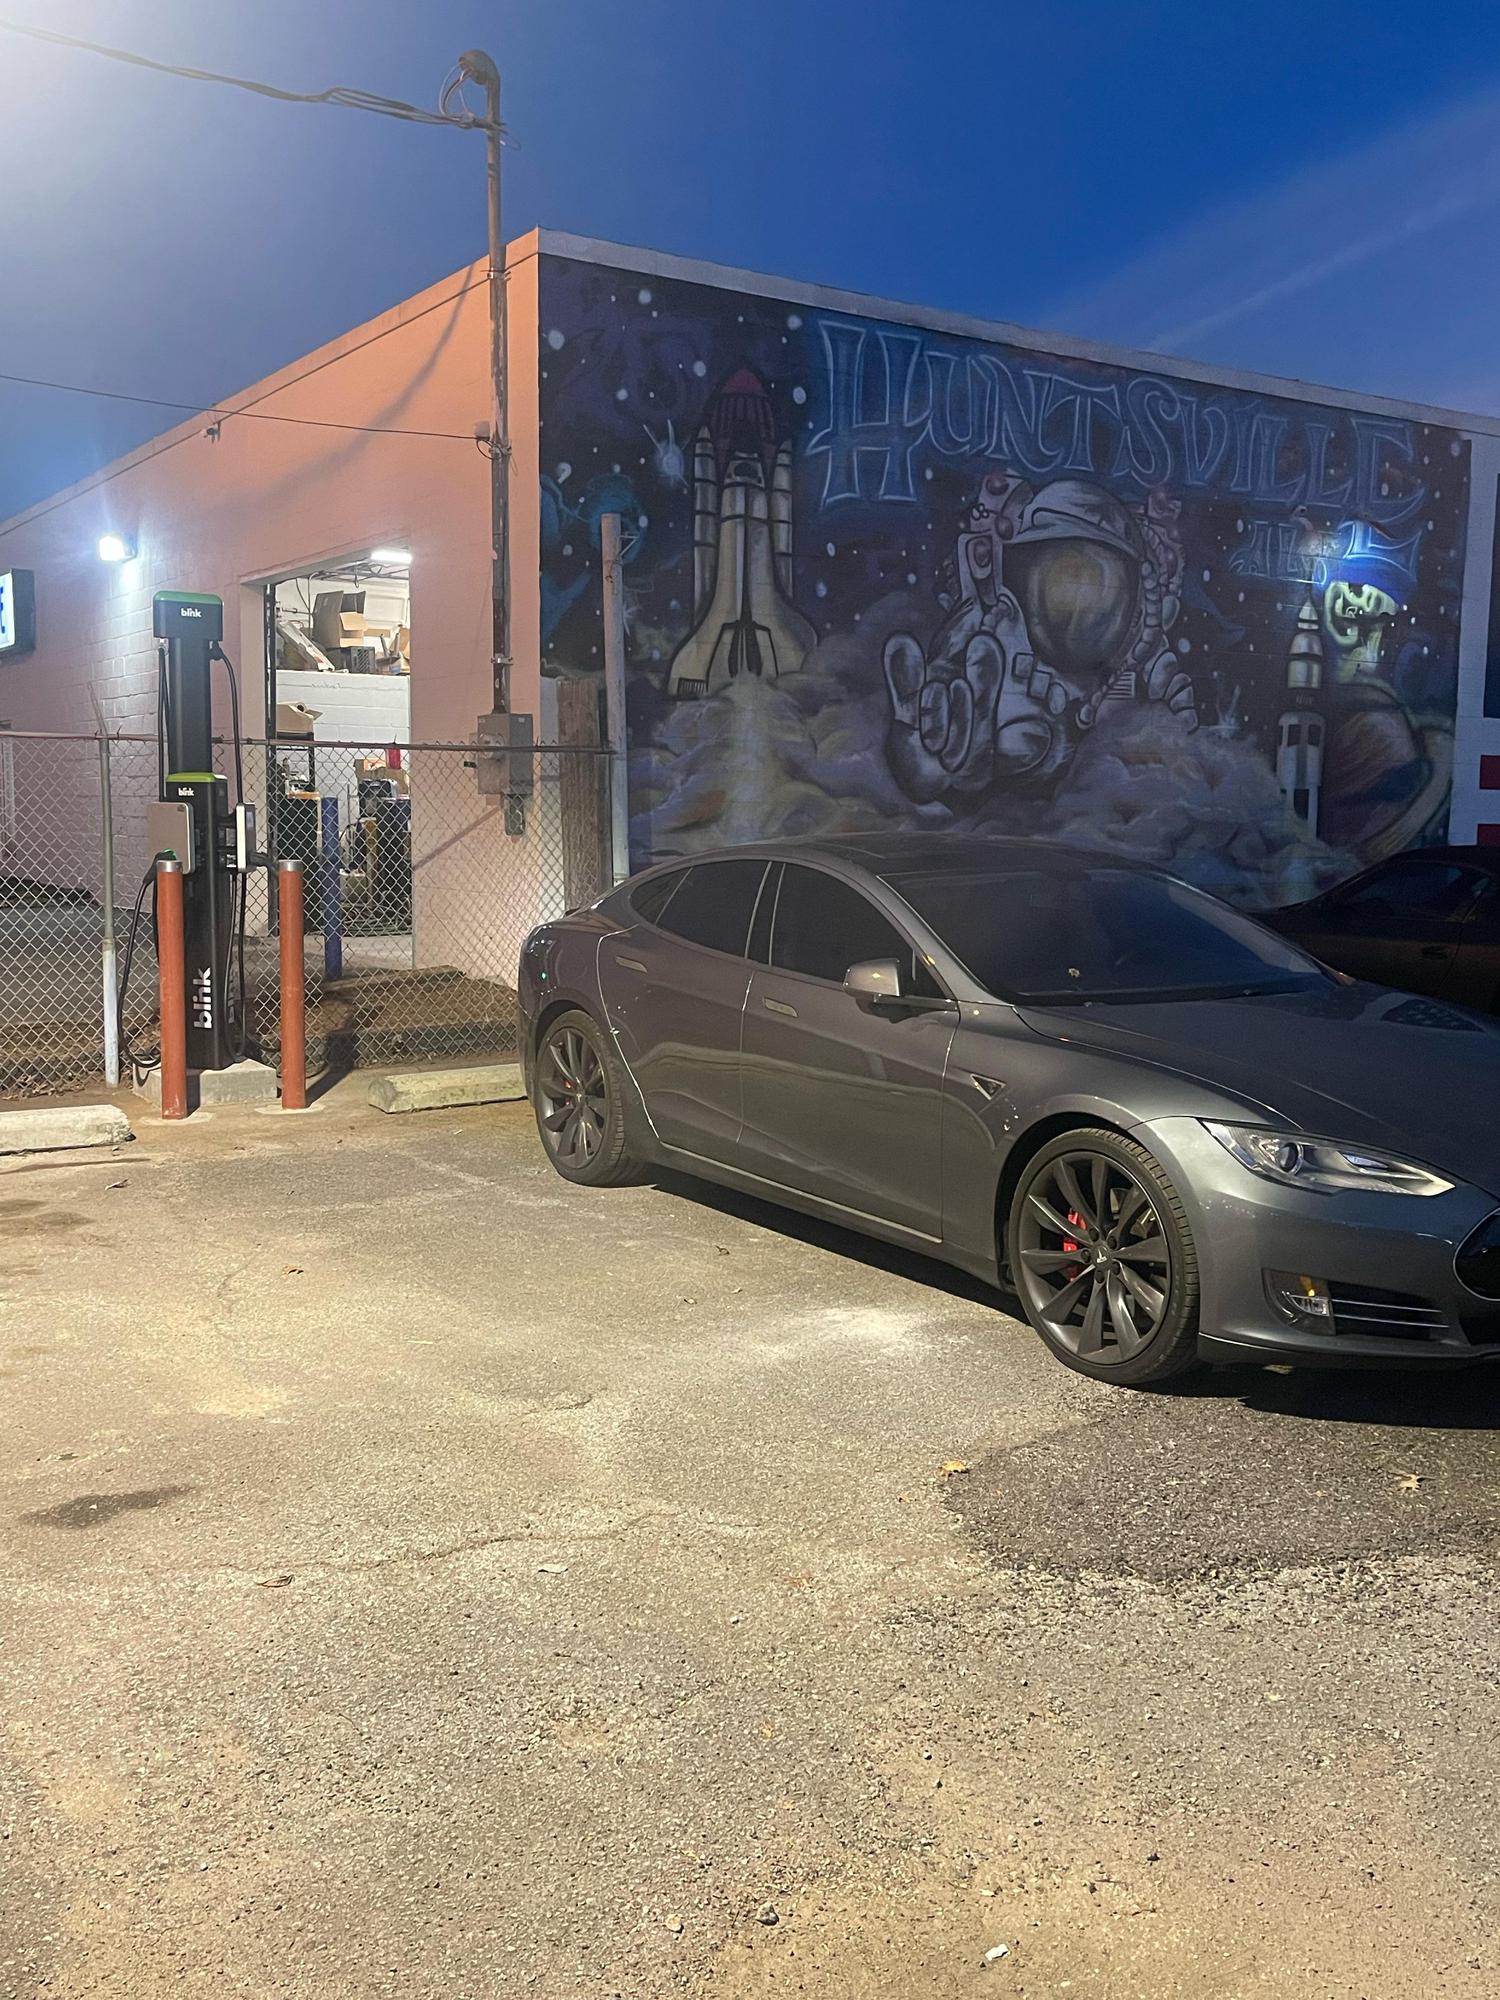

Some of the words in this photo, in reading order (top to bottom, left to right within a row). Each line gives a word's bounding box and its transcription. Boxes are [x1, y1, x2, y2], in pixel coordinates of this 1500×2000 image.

[805, 319, 1426, 583] HUNTSVILLE
[180, 607, 202, 618] blink
[177, 787, 195, 796] blink
[192, 967, 213, 1029] blink
